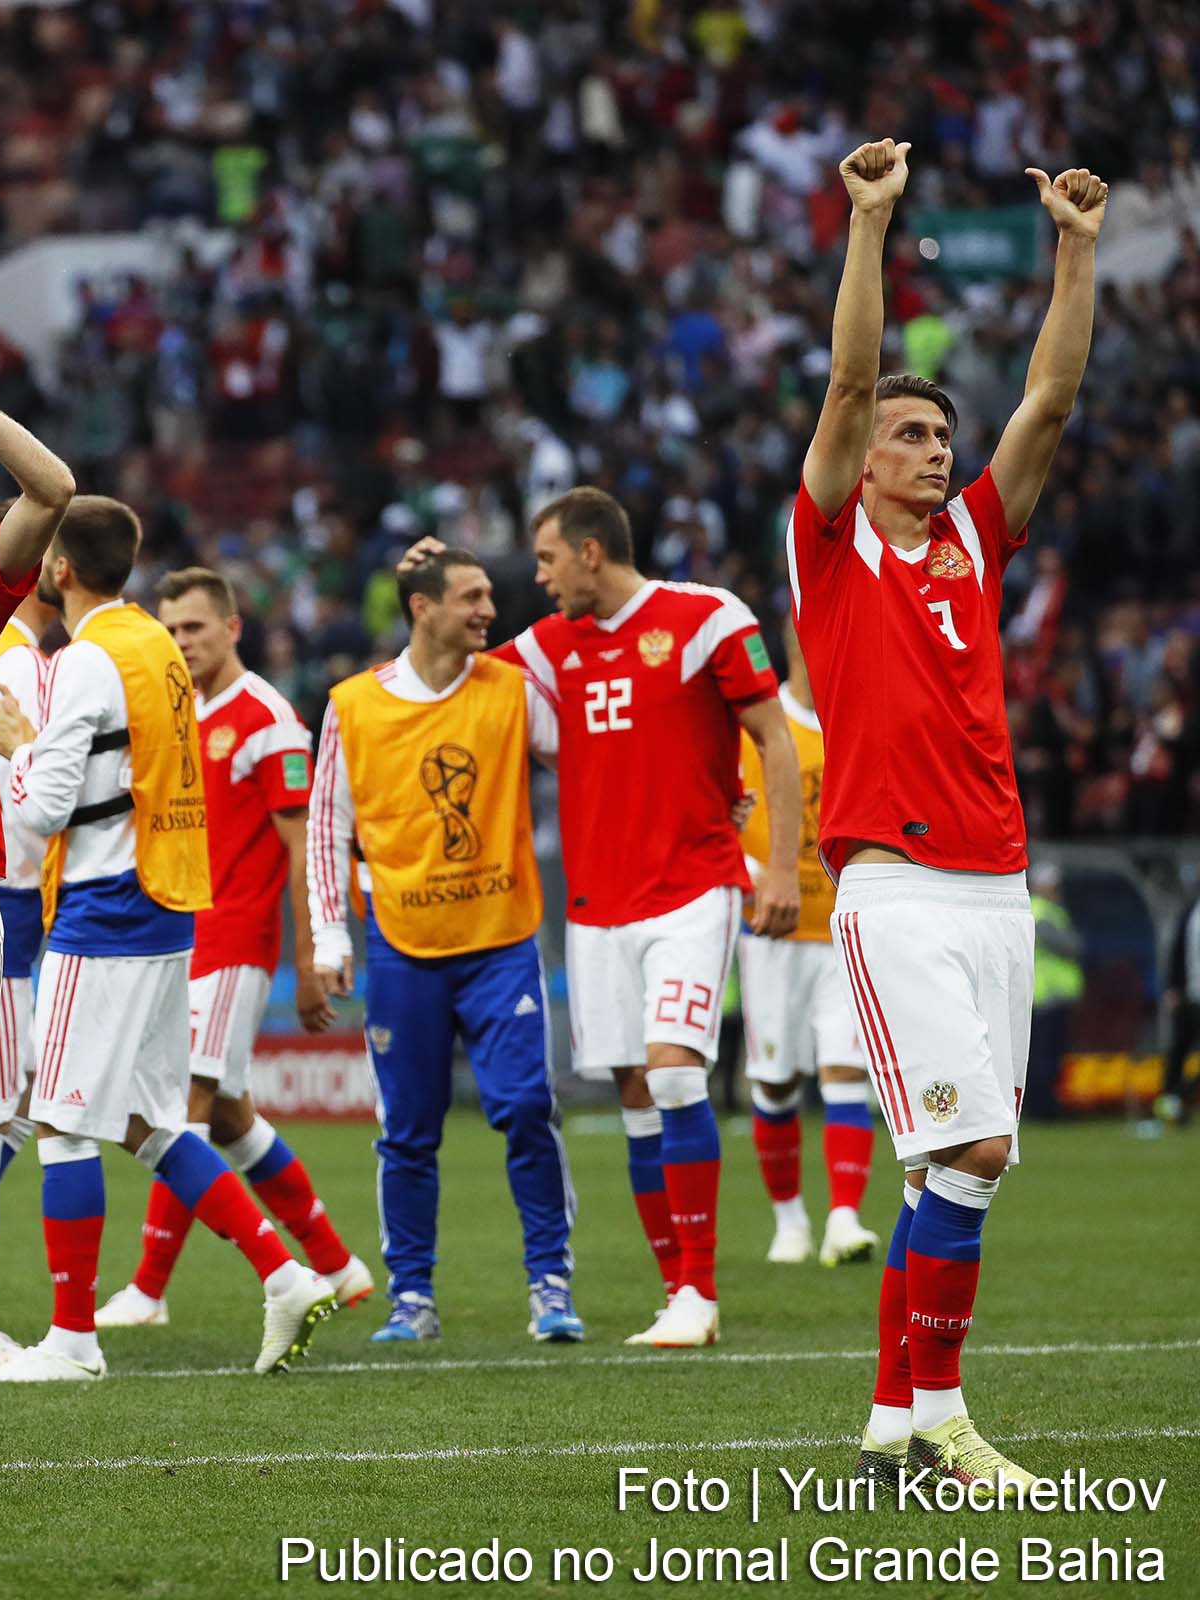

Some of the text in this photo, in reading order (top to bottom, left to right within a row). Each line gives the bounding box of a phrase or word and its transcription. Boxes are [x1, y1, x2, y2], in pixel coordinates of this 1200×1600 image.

[927, 599, 968, 650] 7
[584, 677, 633, 735] 22
[400, 881, 481, 910] RUSSIA
[656, 978, 712, 1031] 22
